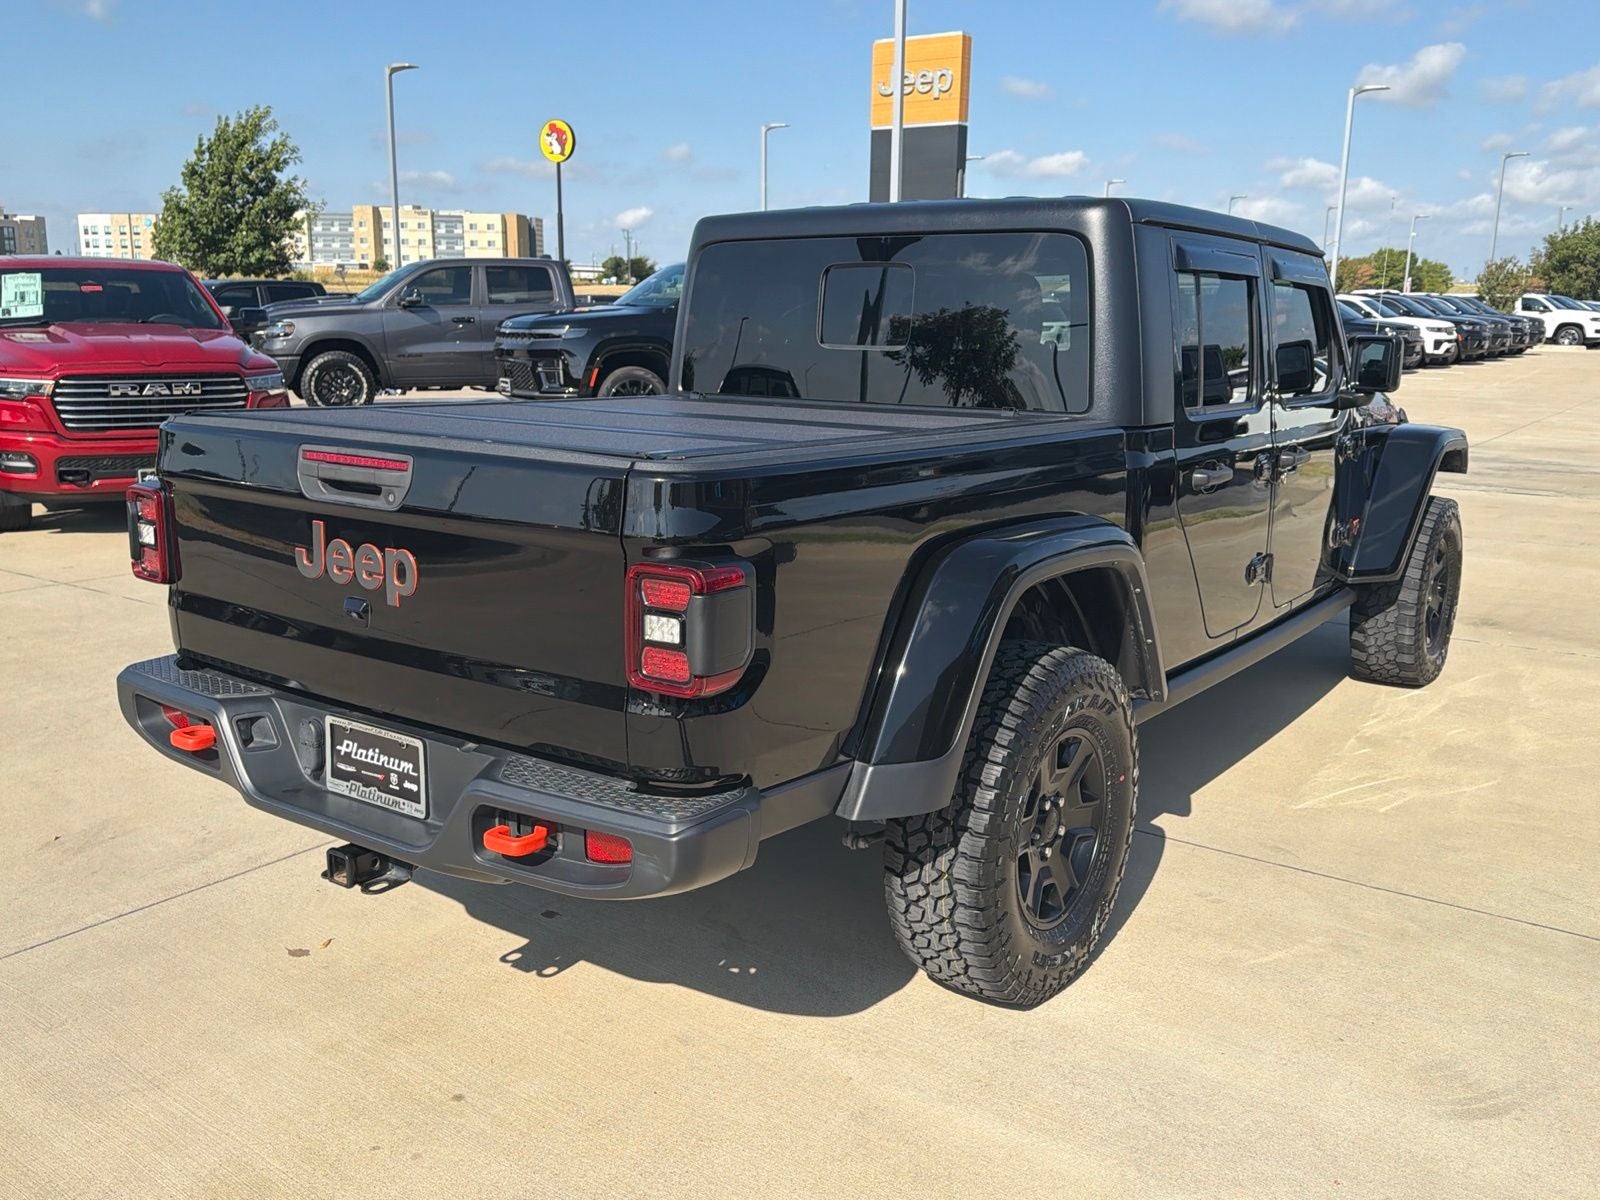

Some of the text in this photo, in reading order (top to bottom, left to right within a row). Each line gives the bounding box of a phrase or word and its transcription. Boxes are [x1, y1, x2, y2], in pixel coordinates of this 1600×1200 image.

[109, 383, 202, 397] RAM
[294, 519, 418, 608] Jeep
[336, 739, 418, 776] Platinum
[348, 782, 405, 810] Platinum
